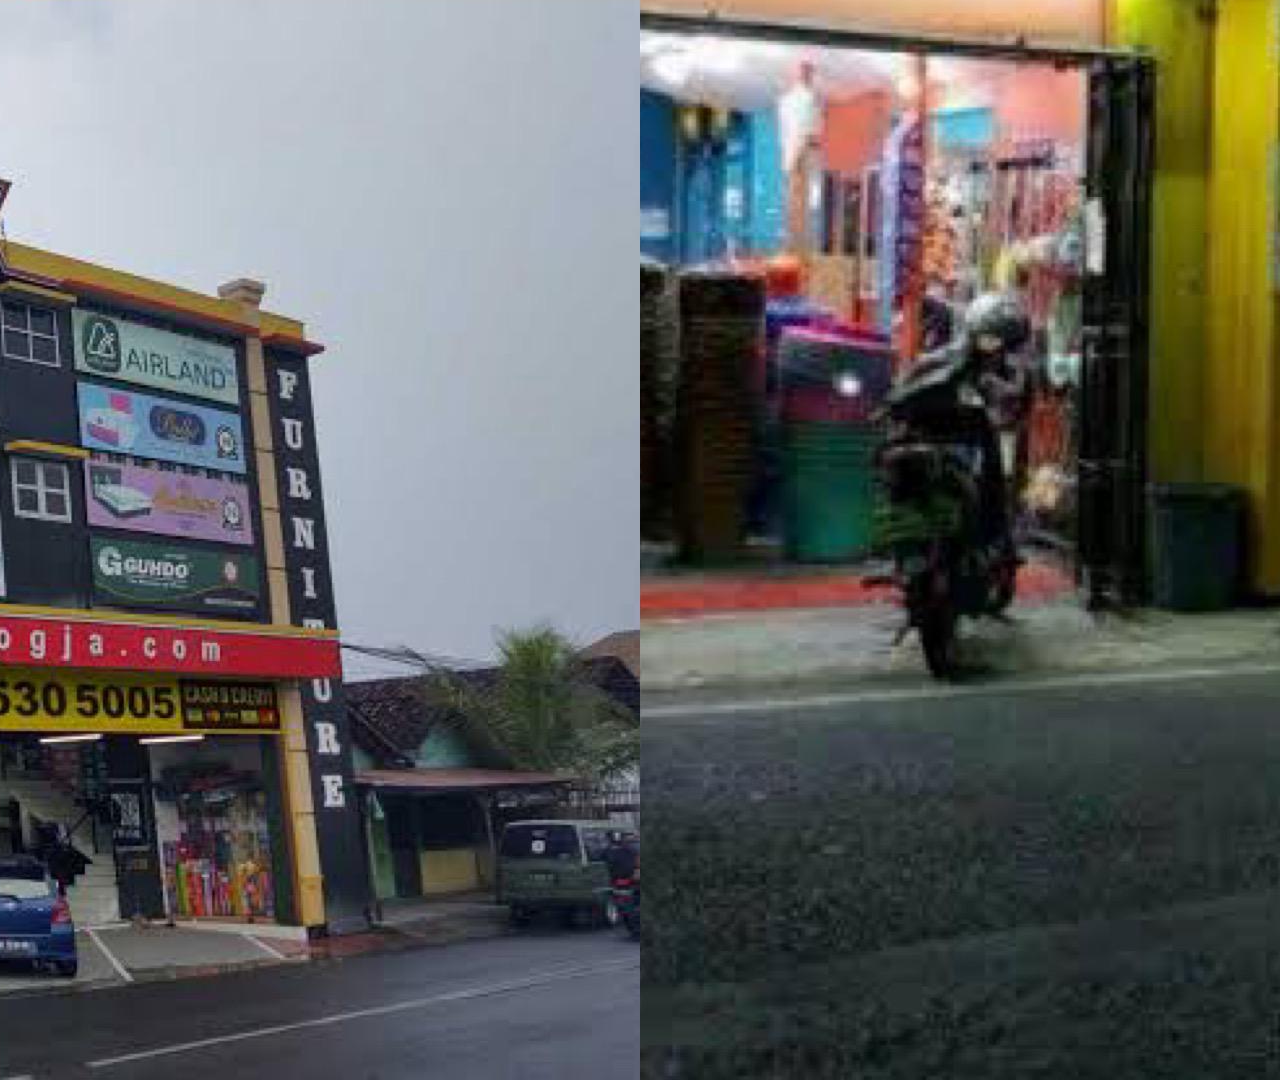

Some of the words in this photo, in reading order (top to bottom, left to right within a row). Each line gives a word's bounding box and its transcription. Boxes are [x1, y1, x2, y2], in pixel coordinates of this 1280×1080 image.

[126, 348, 226, 390] AIRLAND
[124, 556, 189, 580] GUHDO
[75, 683, 176, 719] 5005
